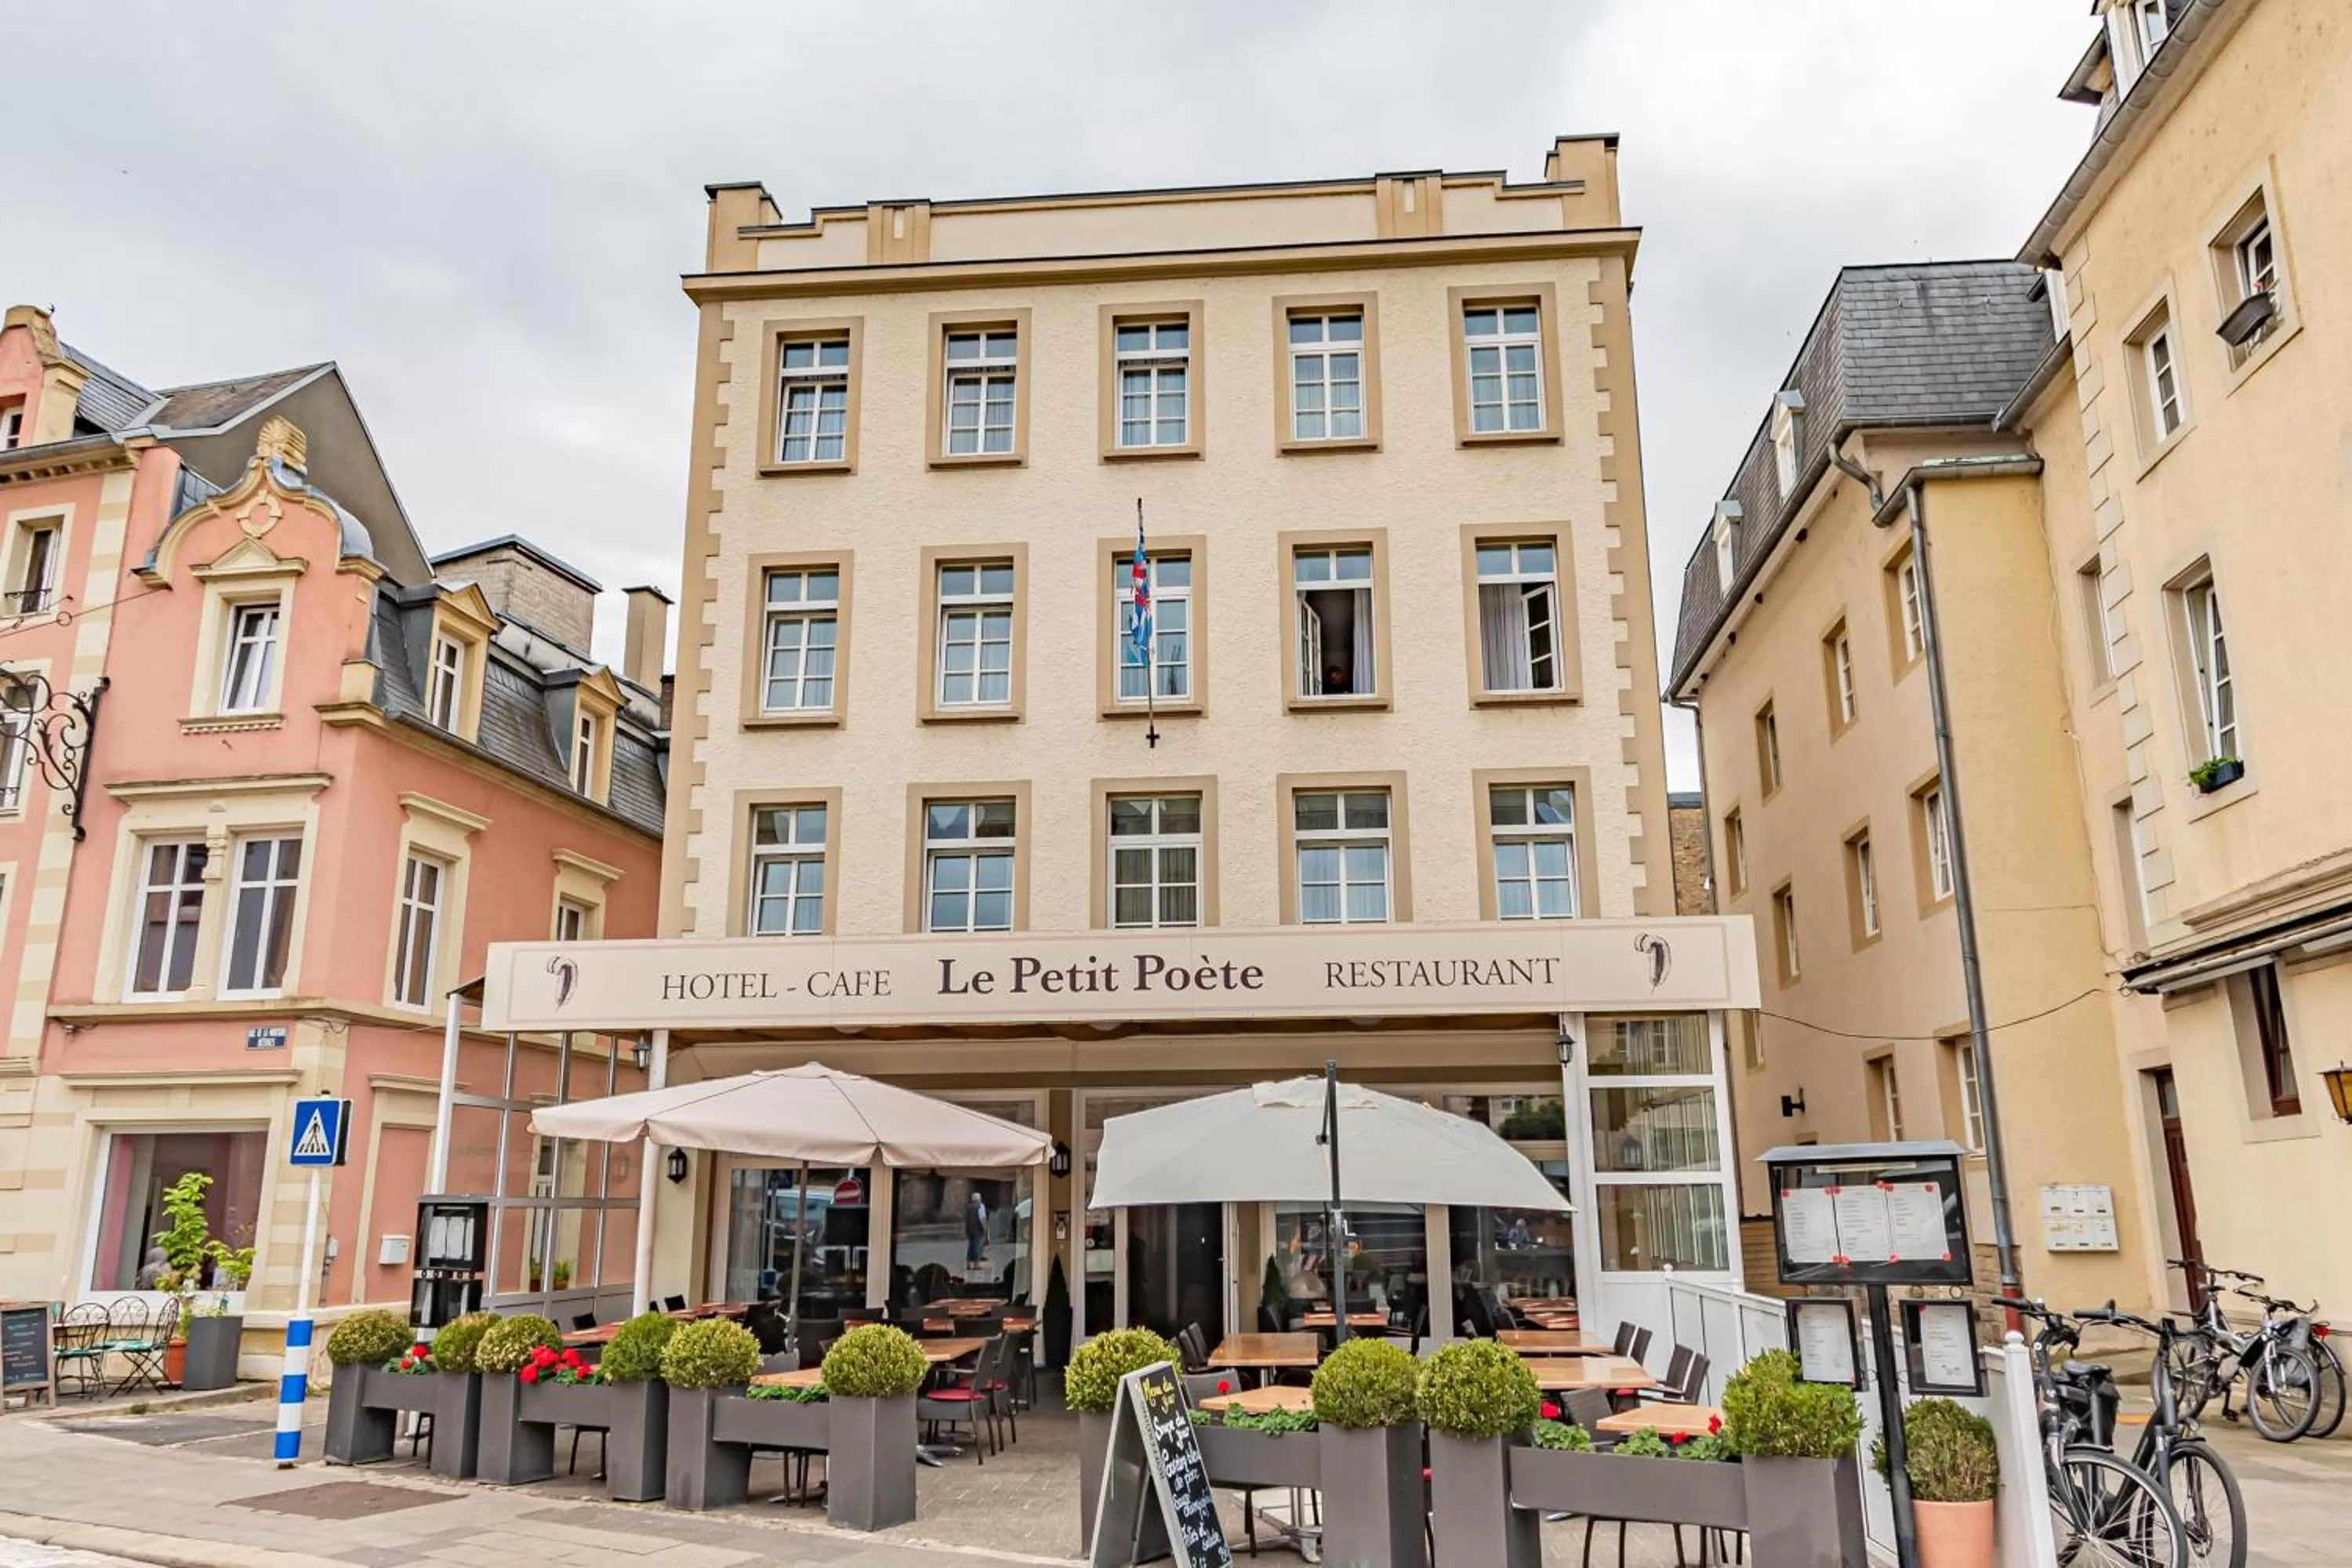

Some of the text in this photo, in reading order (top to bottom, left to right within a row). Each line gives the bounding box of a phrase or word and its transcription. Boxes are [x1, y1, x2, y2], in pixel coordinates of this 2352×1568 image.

[662, 973, 778, 1000] HOTEL
[807, 970, 892, 998] CAFE
[938, 954, 1265, 995] Le Petit Poète
[1323, 957, 1561, 989] RESTAURANT
